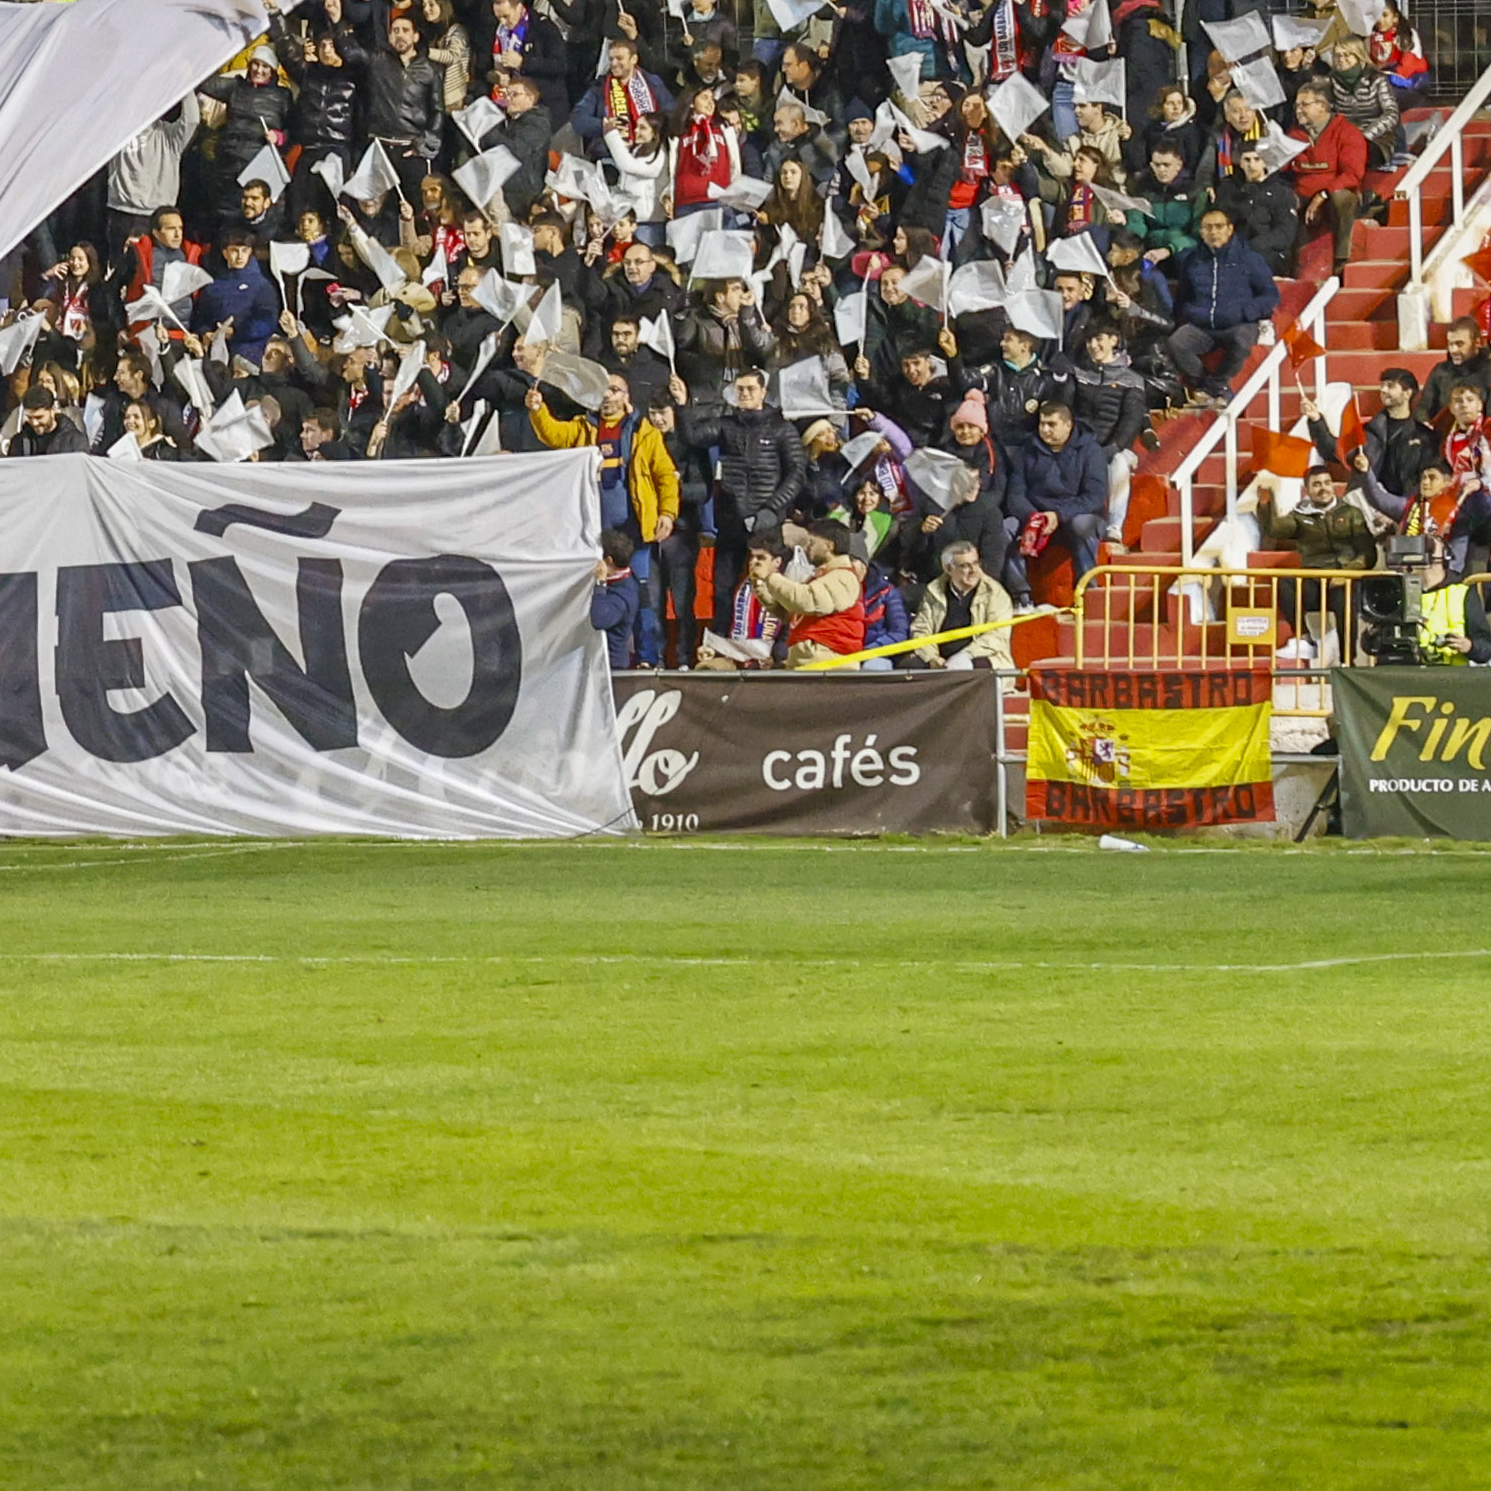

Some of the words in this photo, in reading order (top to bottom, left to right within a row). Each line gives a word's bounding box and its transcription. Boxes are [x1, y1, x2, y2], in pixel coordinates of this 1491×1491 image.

[1042, 671, 1252, 709] BARBASTRO
[1369, 696, 1491, 771] Fin
[763, 734, 920, 790] cafés
[1046, 780, 1256, 824] BARBASTRO
[1369, 778, 1454, 792] PRODUCTO
[1459, 779, 1479, 792] DE
[652, 813, 700, 832] 1910
